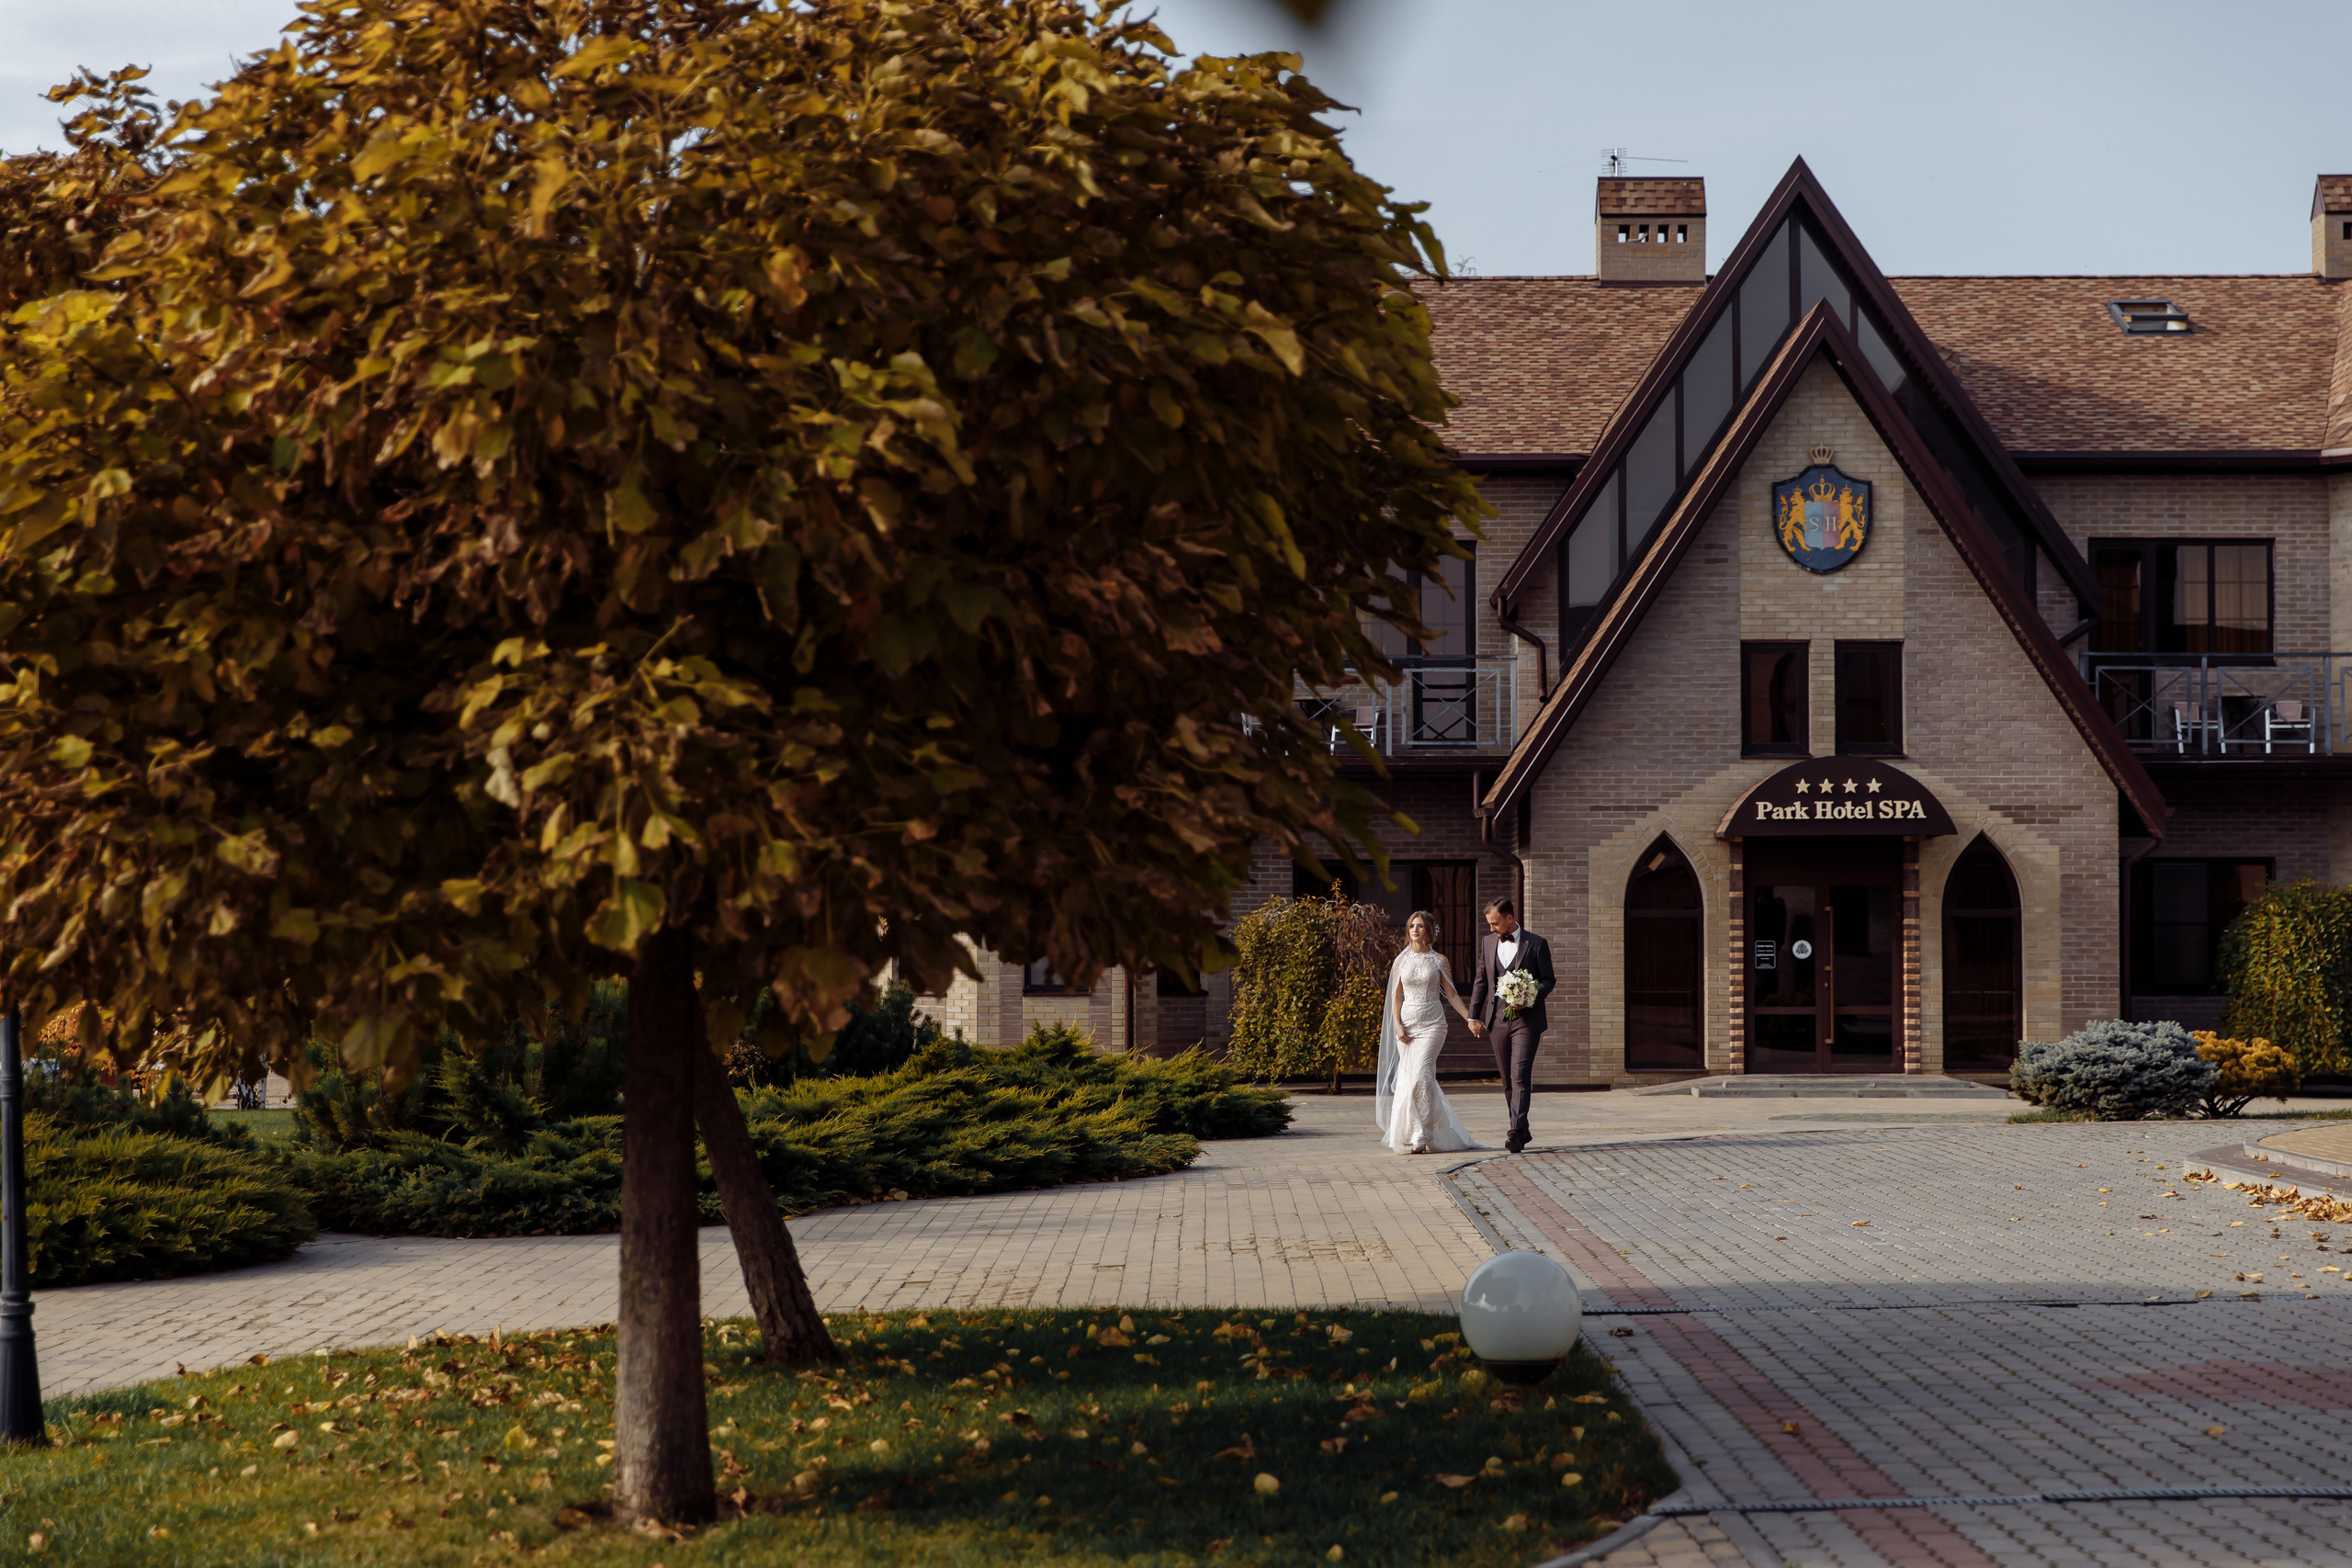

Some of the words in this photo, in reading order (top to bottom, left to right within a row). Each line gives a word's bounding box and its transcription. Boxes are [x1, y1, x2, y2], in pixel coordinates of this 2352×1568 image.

[1755, 800, 1810, 820] Park
[1814, 800, 1874, 819] Hotel
[1878, 799, 1927, 819] SPA
